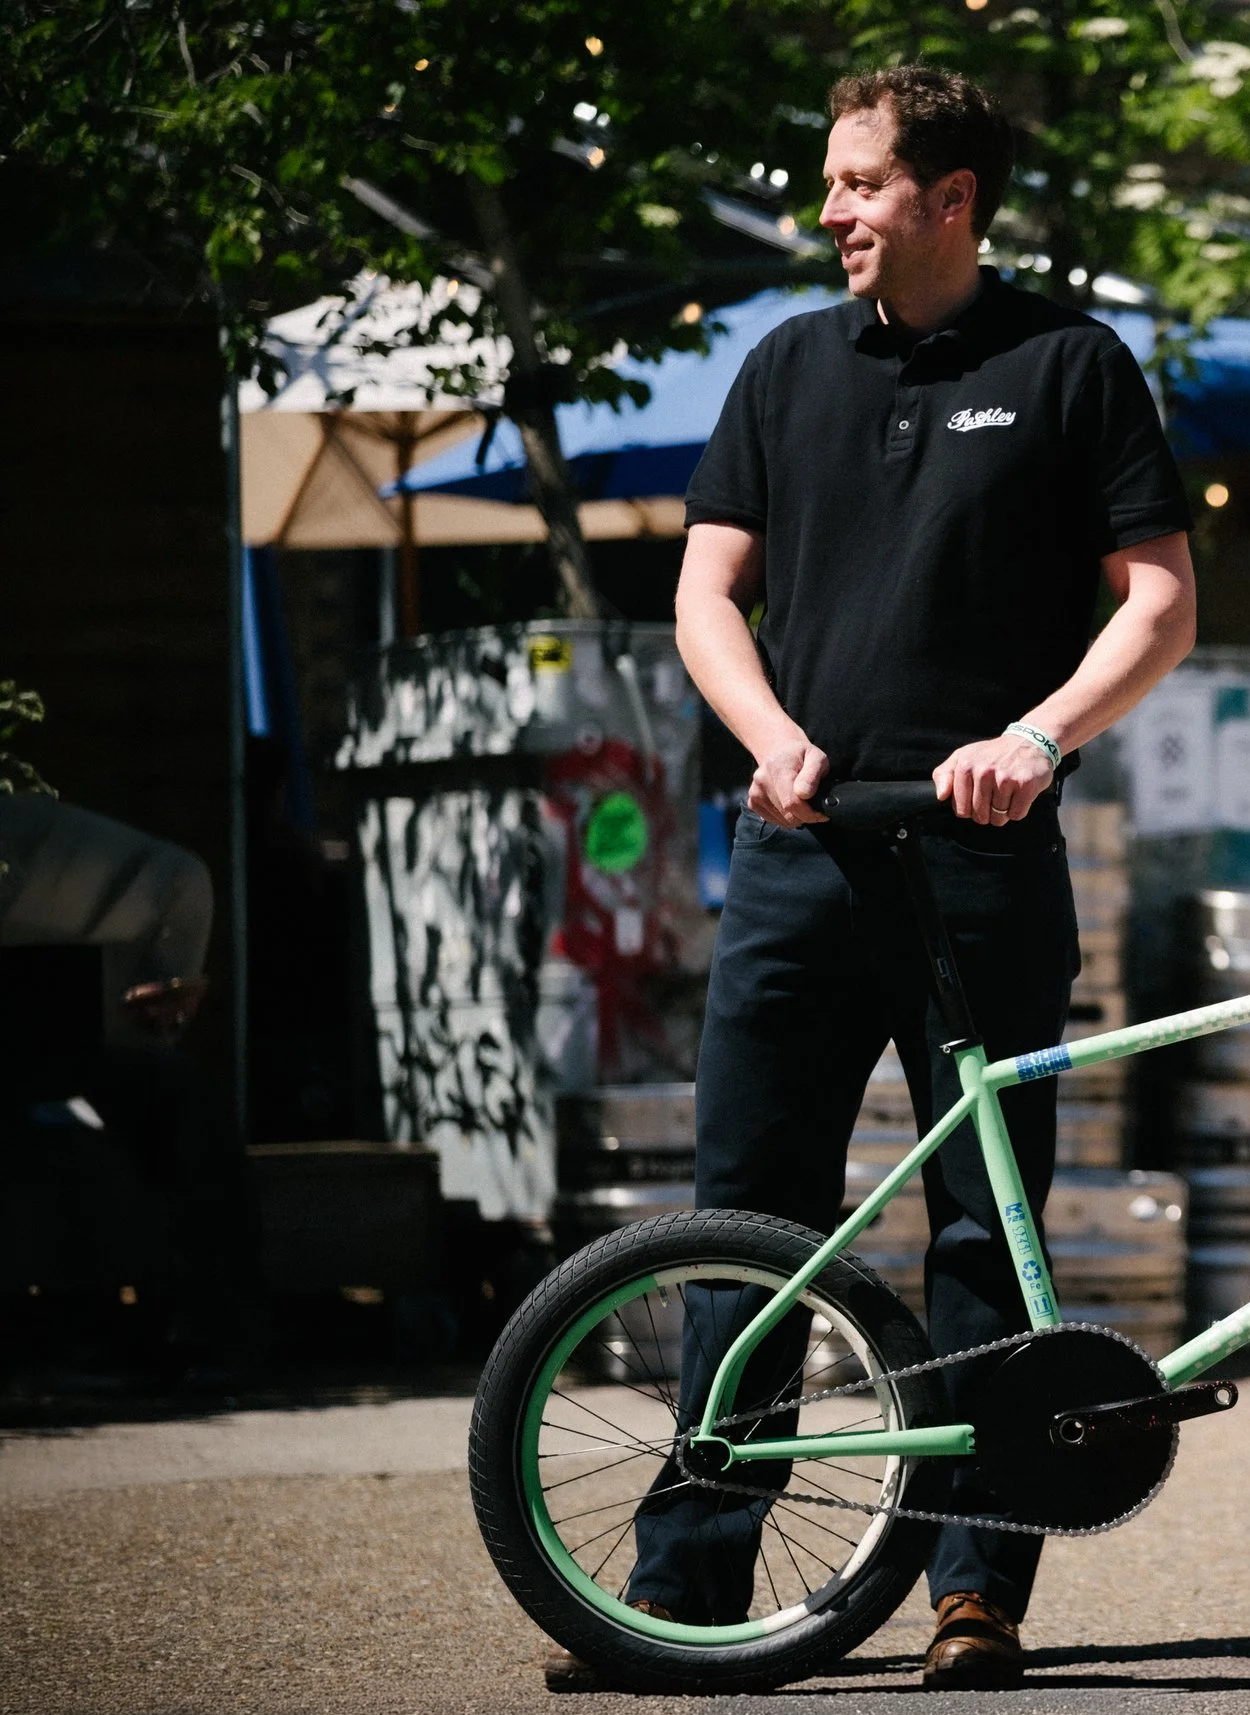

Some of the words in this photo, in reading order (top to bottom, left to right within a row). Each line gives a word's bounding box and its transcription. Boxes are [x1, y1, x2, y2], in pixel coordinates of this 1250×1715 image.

[947, 406, 1016, 432] Pashley
[1018, 1056, 1072, 1078] SKYLINE
[1005, 1202, 1023, 1217] R
[1030, 1282, 1041, 1291] Fe
